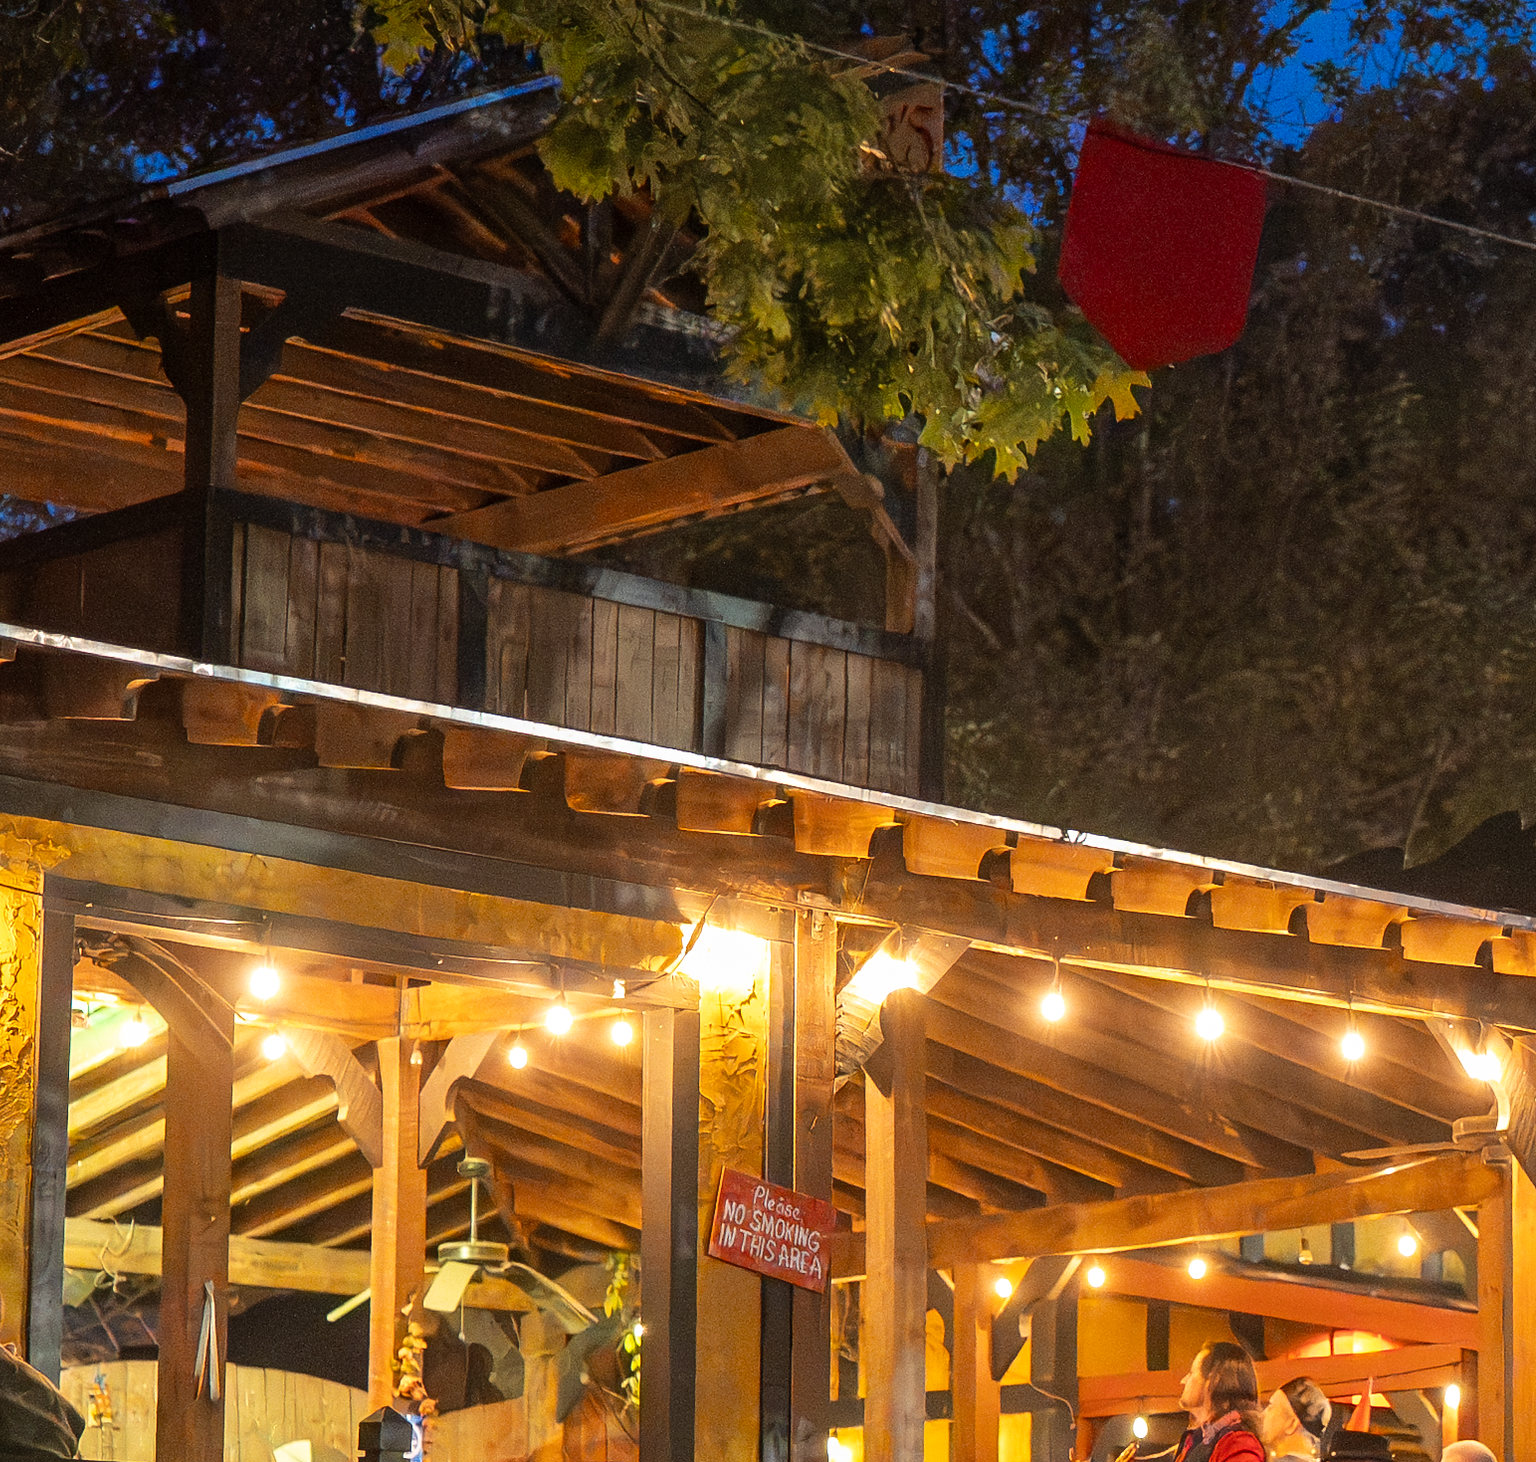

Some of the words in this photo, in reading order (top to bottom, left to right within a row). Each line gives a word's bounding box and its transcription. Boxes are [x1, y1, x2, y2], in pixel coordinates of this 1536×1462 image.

[718, 1222, 737, 1248] IN
[740, 1228, 776, 1262] THIS
[778, 1244, 822, 1280] AREA
[723, 1198, 745, 1225] NO
[749, 1210, 821, 1253] SMOKING
